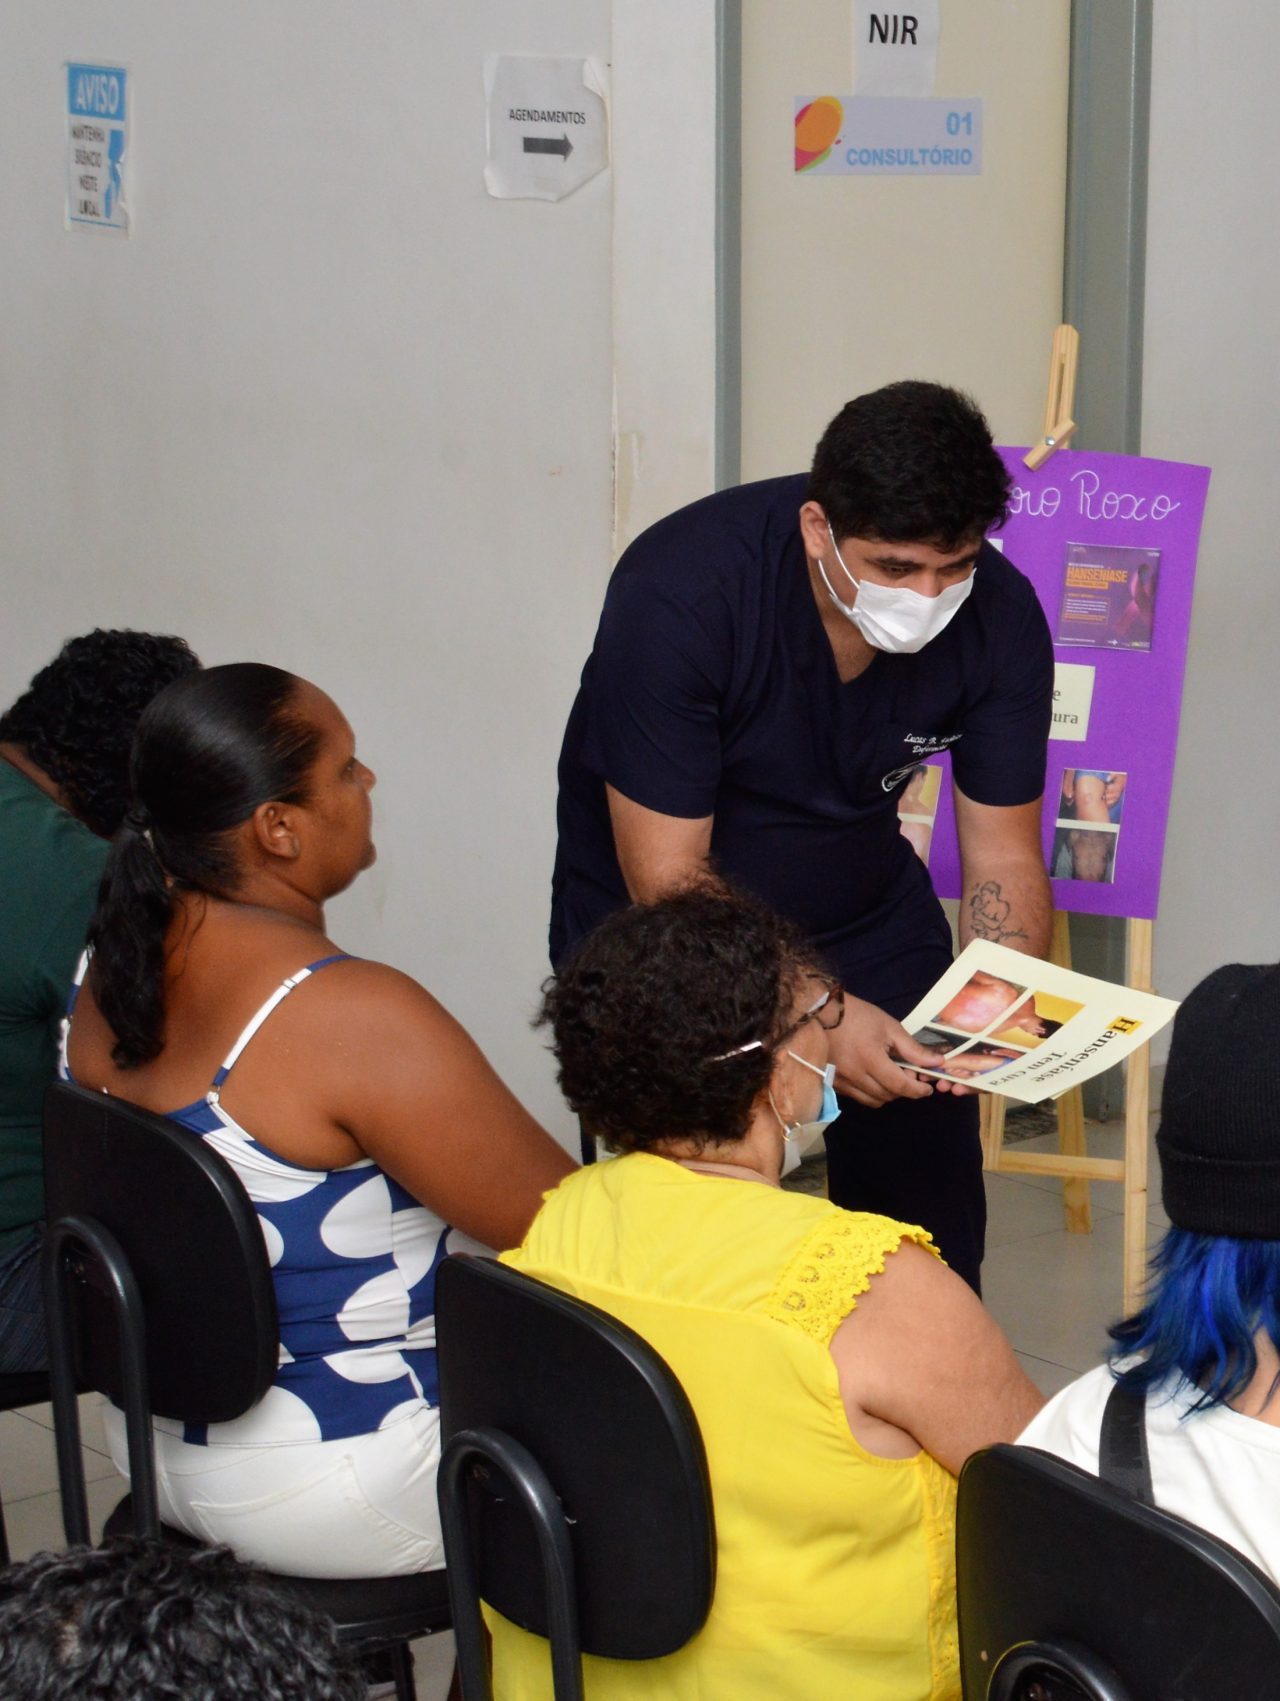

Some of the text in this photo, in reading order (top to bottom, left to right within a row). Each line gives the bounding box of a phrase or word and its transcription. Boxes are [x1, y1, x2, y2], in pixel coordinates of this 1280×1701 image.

[868, 14, 918, 45] NIR
[76, 74, 119, 114] AVISO
[509, 108, 586, 125] AGENDAMENTOS
[946, 111, 973, 136] 01
[846, 145, 973, 166] CONSULTÓRIO
[1070, 470, 1181, 521] Roxo
[1067, 567, 1128, 583] HANSENÍASE
[1032, 1018, 1136, 1083] Hanseníase
[989, 1051, 1067, 1086] Tem cura
